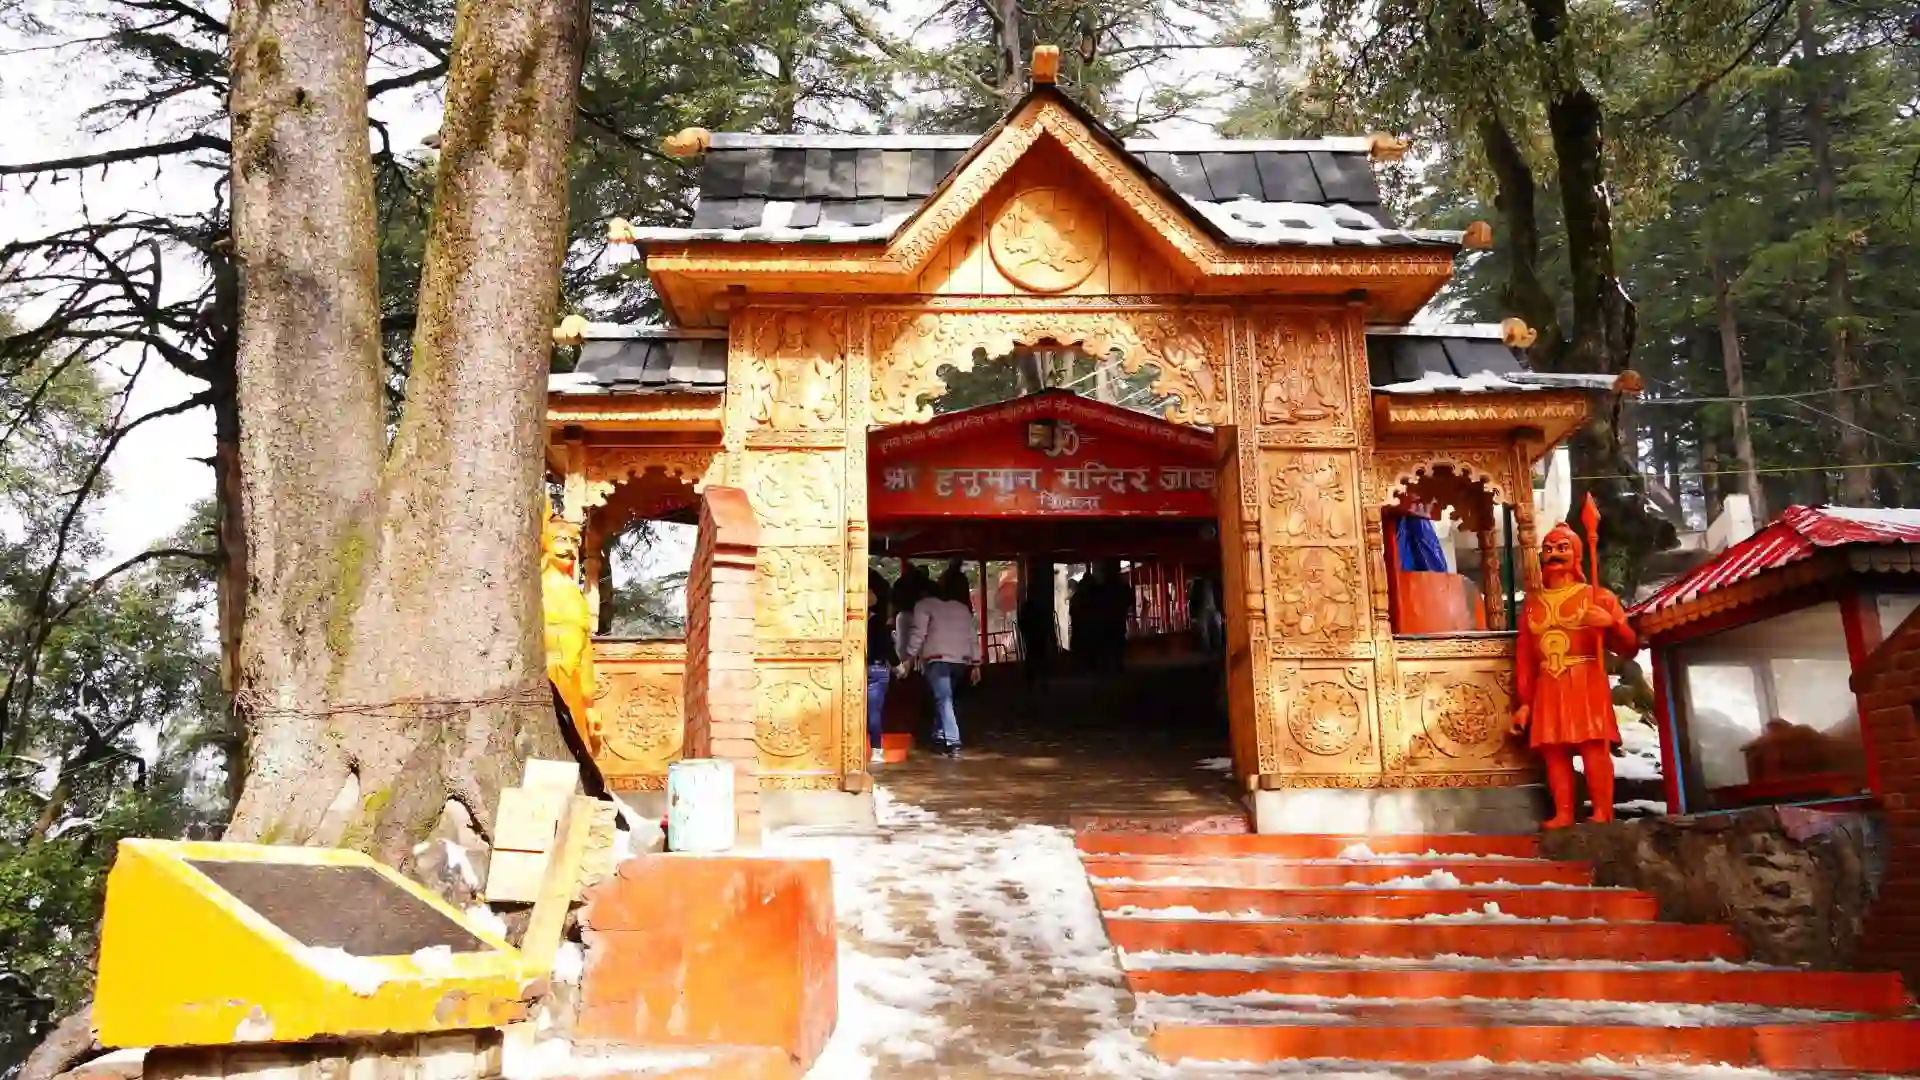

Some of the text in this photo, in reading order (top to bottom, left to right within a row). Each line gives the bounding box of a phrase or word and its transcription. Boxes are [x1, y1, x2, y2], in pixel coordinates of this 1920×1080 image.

[935, 467, 1043, 497] हनुमान
[1054, 460, 1151, 494] मन्दिर
[1158, 465, 1217, 490] जाख
